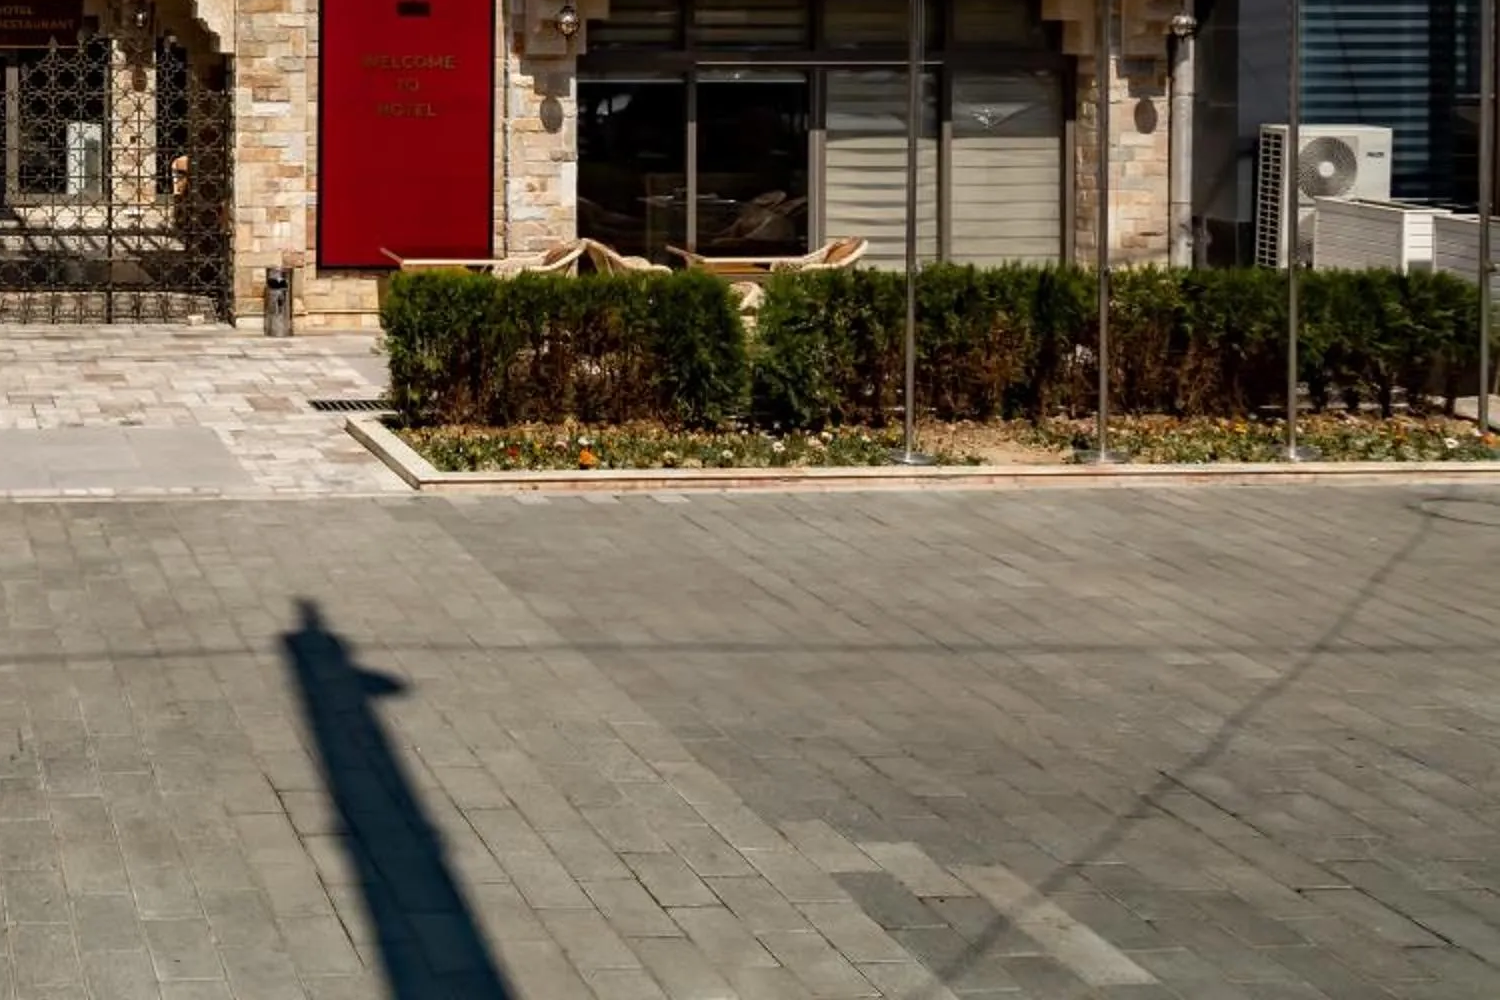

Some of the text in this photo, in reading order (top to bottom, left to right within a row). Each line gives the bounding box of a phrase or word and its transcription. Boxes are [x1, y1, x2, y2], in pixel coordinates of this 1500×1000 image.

[362, 55, 456, 69] WELCOME
[396, 77, 420, 92] TO
[377, 103, 438, 117] HOTEL
